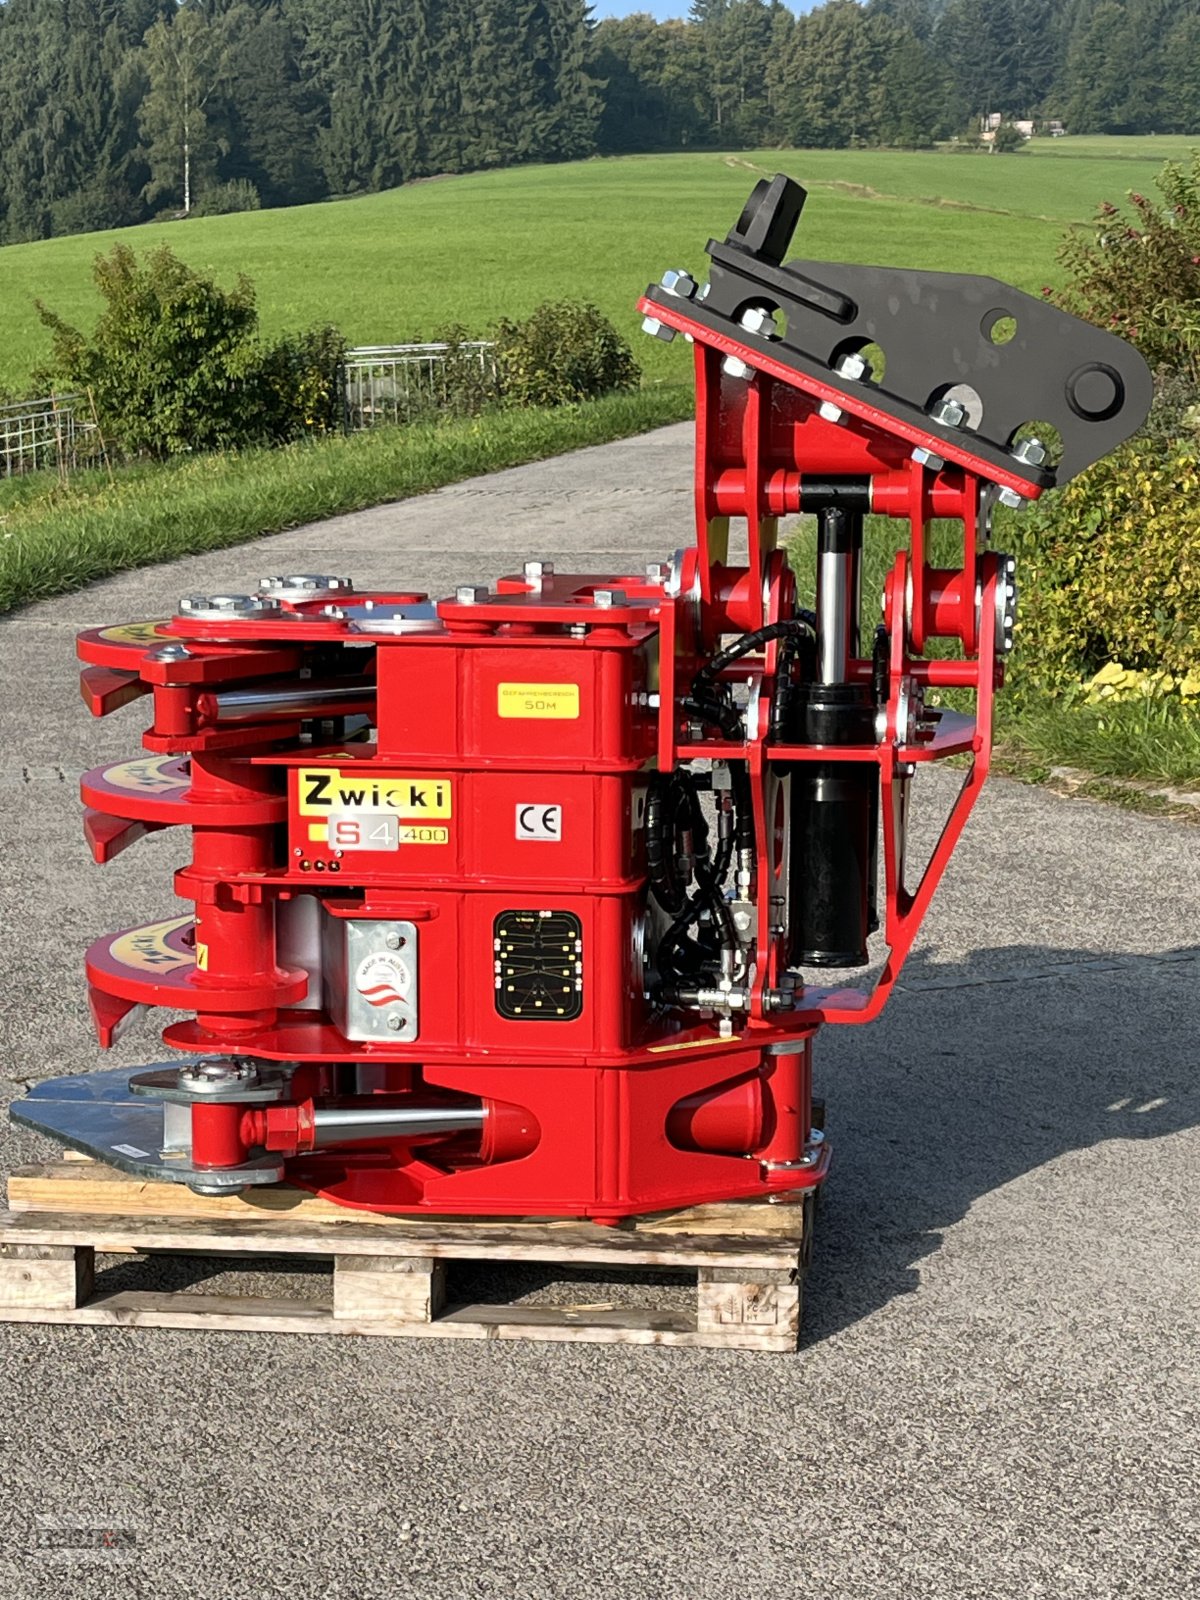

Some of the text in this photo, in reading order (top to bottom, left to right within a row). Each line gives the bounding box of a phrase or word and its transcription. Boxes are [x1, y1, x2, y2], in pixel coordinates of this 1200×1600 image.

[305, 774, 443, 807] Zwicki
[519, 806, 557, 834] CE
[362, 958, 377, 976] MADE
